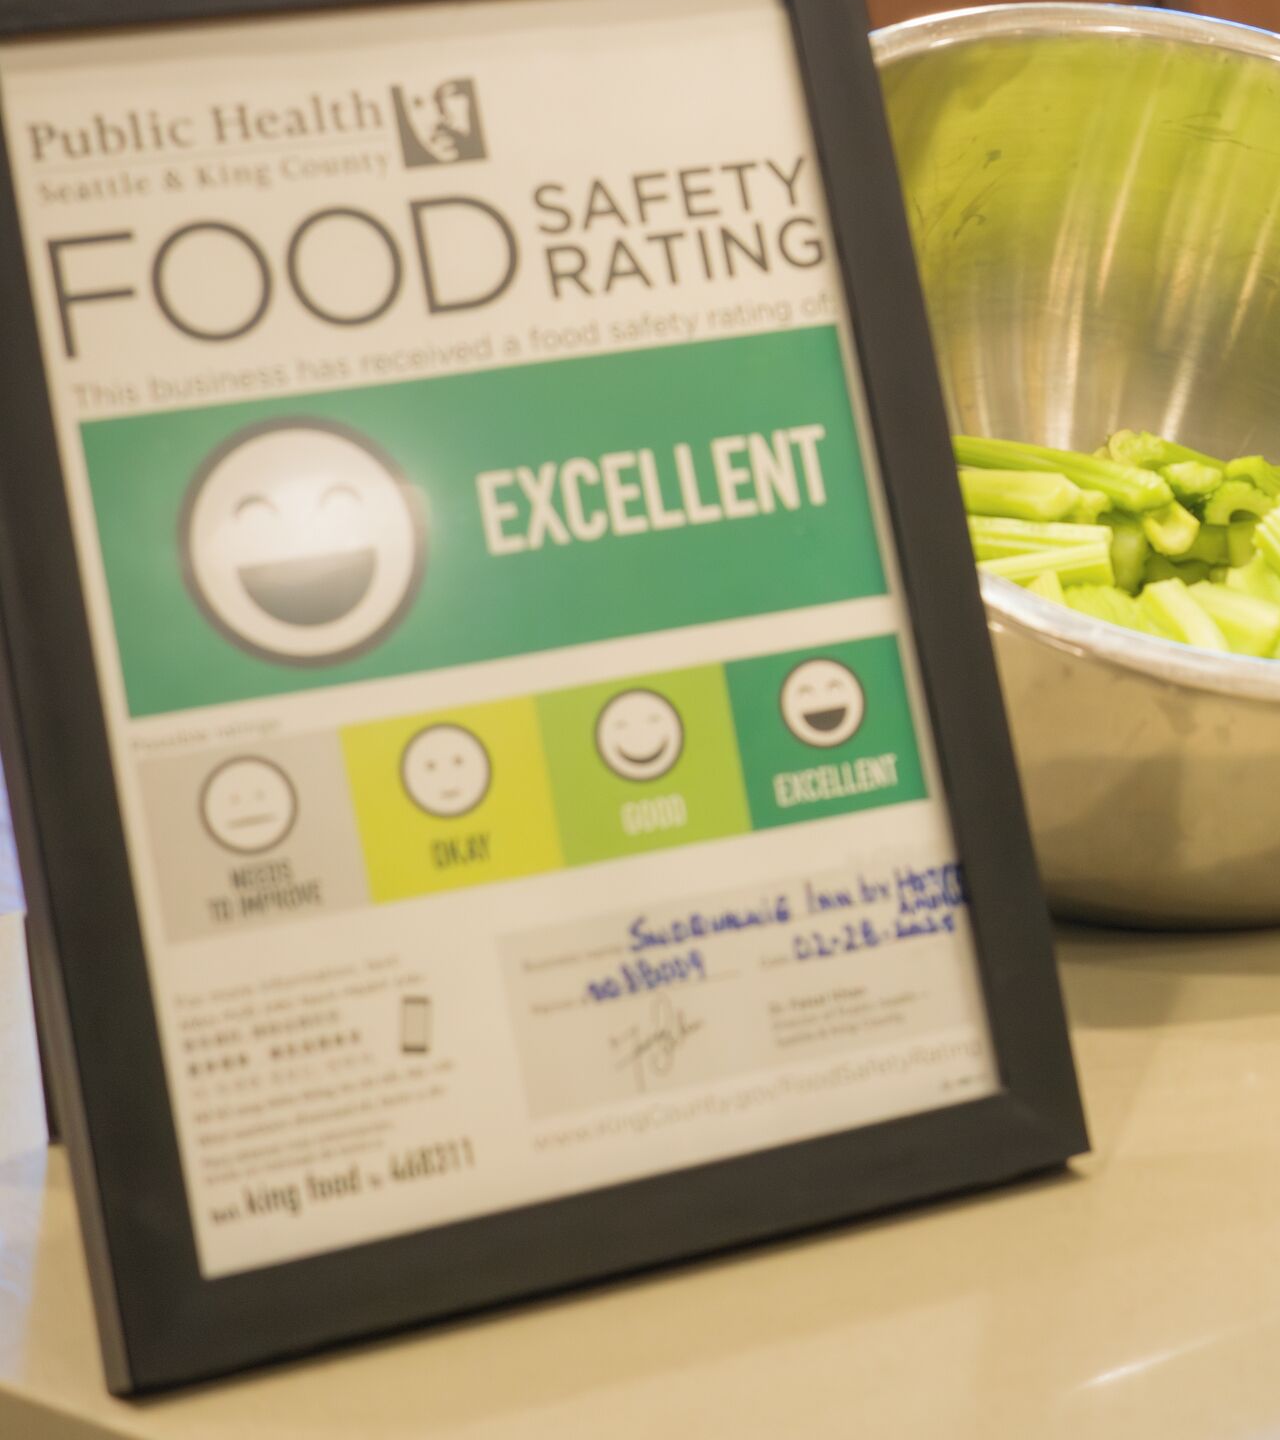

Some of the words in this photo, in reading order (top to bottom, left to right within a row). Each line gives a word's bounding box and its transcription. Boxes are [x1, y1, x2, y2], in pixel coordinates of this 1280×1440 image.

[27, 111, 196, 162] Public
[211, 90, 385, 144] Health
[38, 167, 150, 205] Seattle
[162, 166, 186, 192] &
[198, 159, 272, 191] King
[280, 150, 391, 181] County
[532, 157, 806, 234] SAFETY
[47, 195, 520, 358] FOOD
[545, 217, 826, 300] RATING
[73, 381, 136, 410] This
[148, 363, 287, 398] business
[297, 357, 349, 382] has
[359, 337, 494, 374] received
[502, 335, 522, 355] a
[529, 321, 600, 351] food
[610, 308, 699, 344] safety
[707, 298, 793, 332] rating
[474, 424, 829, 556] EXCELLENT
[772, 753, 898, 808] EXCELLENT
[620, 793, 688, 836] GOOD
[229, 859, 293, 889] NEEDS
[431, 832, 492, 869] OKAY
[240, 879, 323, 915] IMPROVE
[243, 1182, 302, 1218] king
